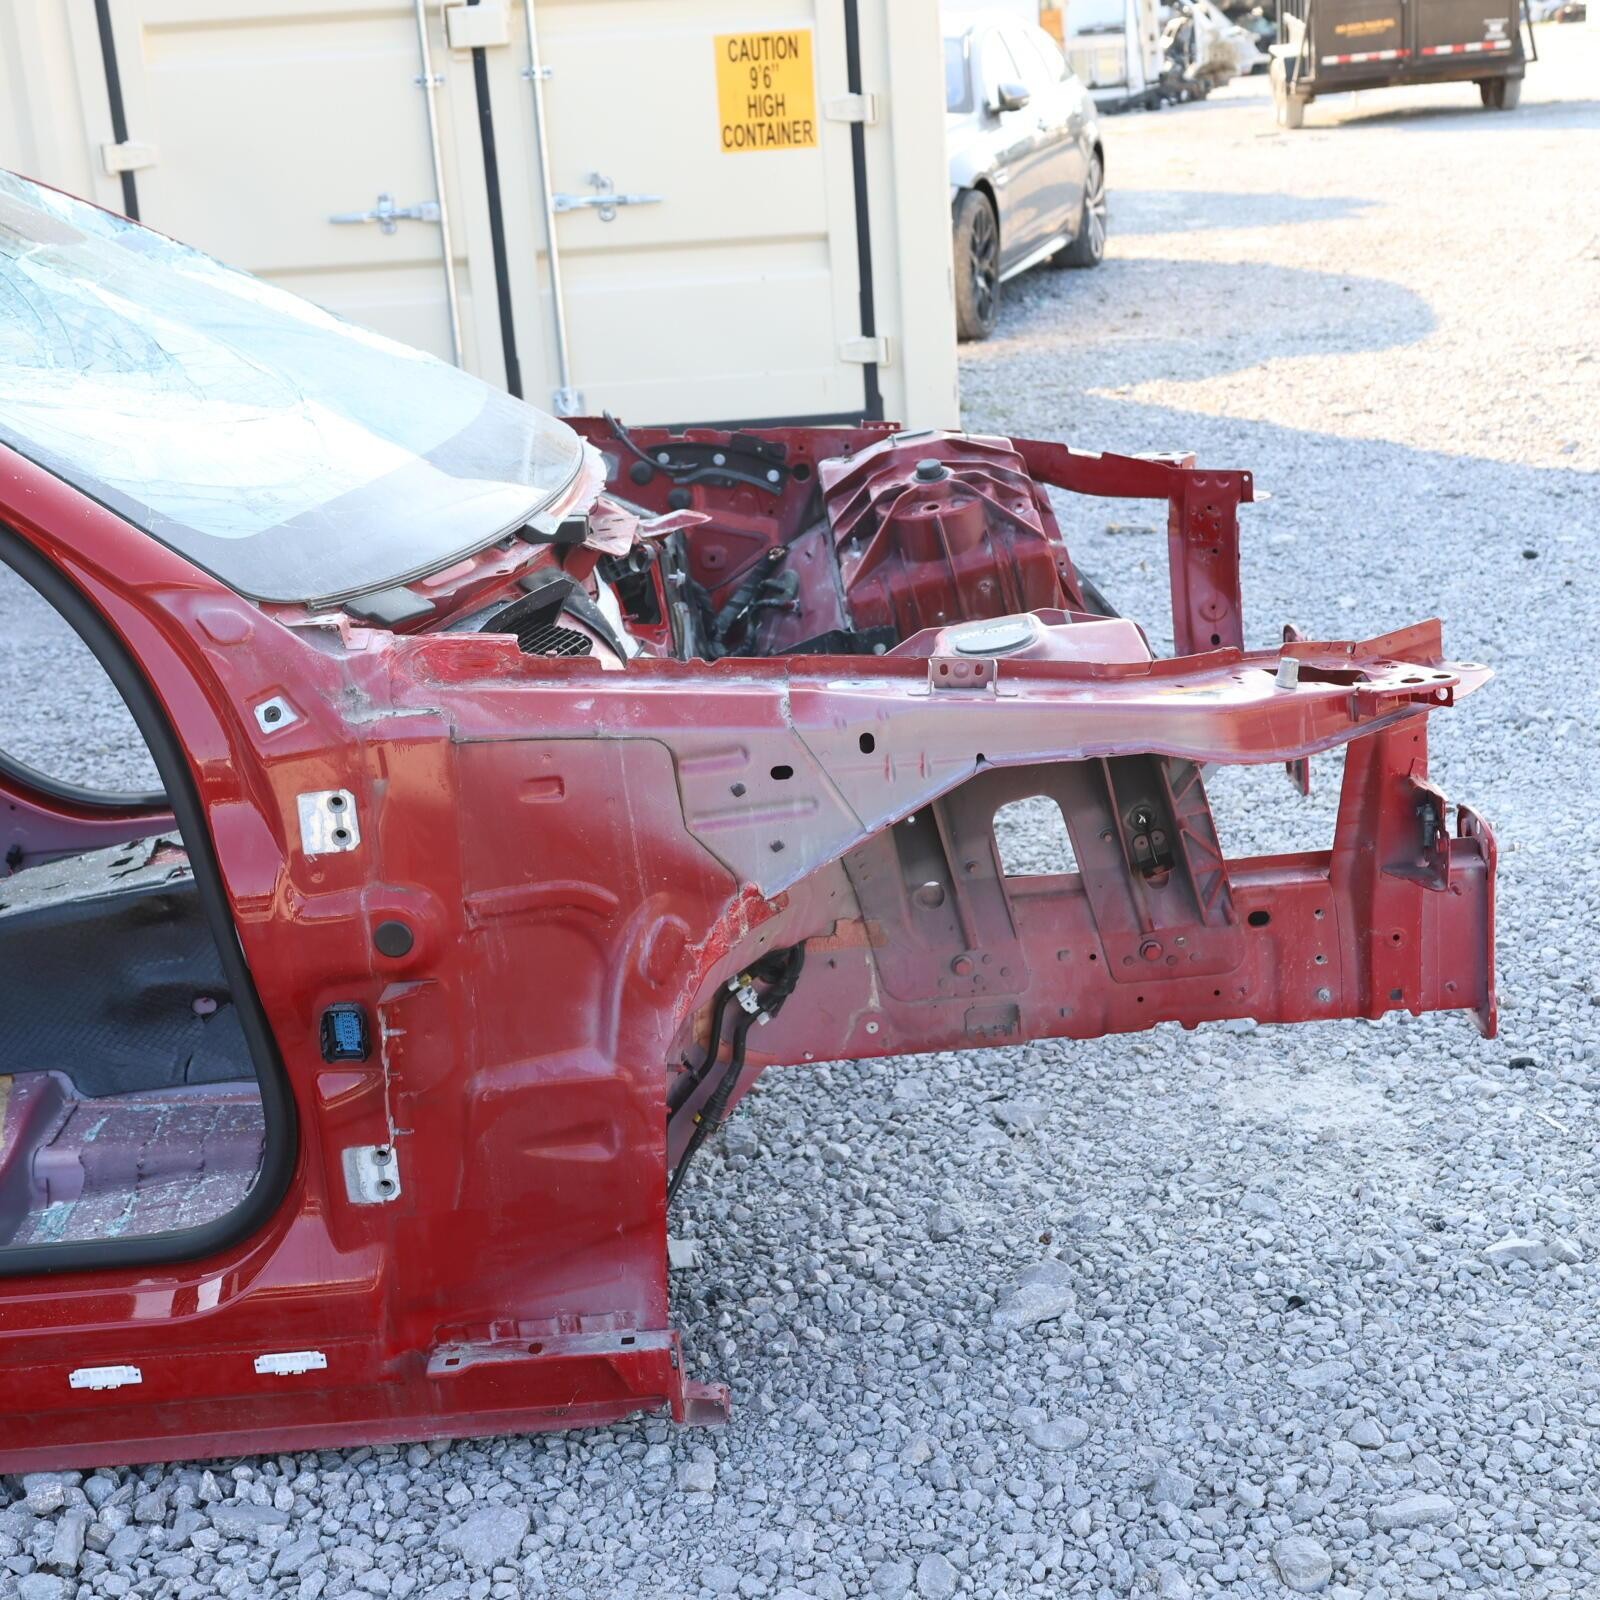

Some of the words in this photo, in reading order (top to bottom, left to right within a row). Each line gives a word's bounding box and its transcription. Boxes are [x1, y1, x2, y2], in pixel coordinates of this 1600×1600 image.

[727, 36, 799, 62] CAUTION
[747, 94, 786, 118] HIGH
[722, 120, 814, 148] CONTAINER
